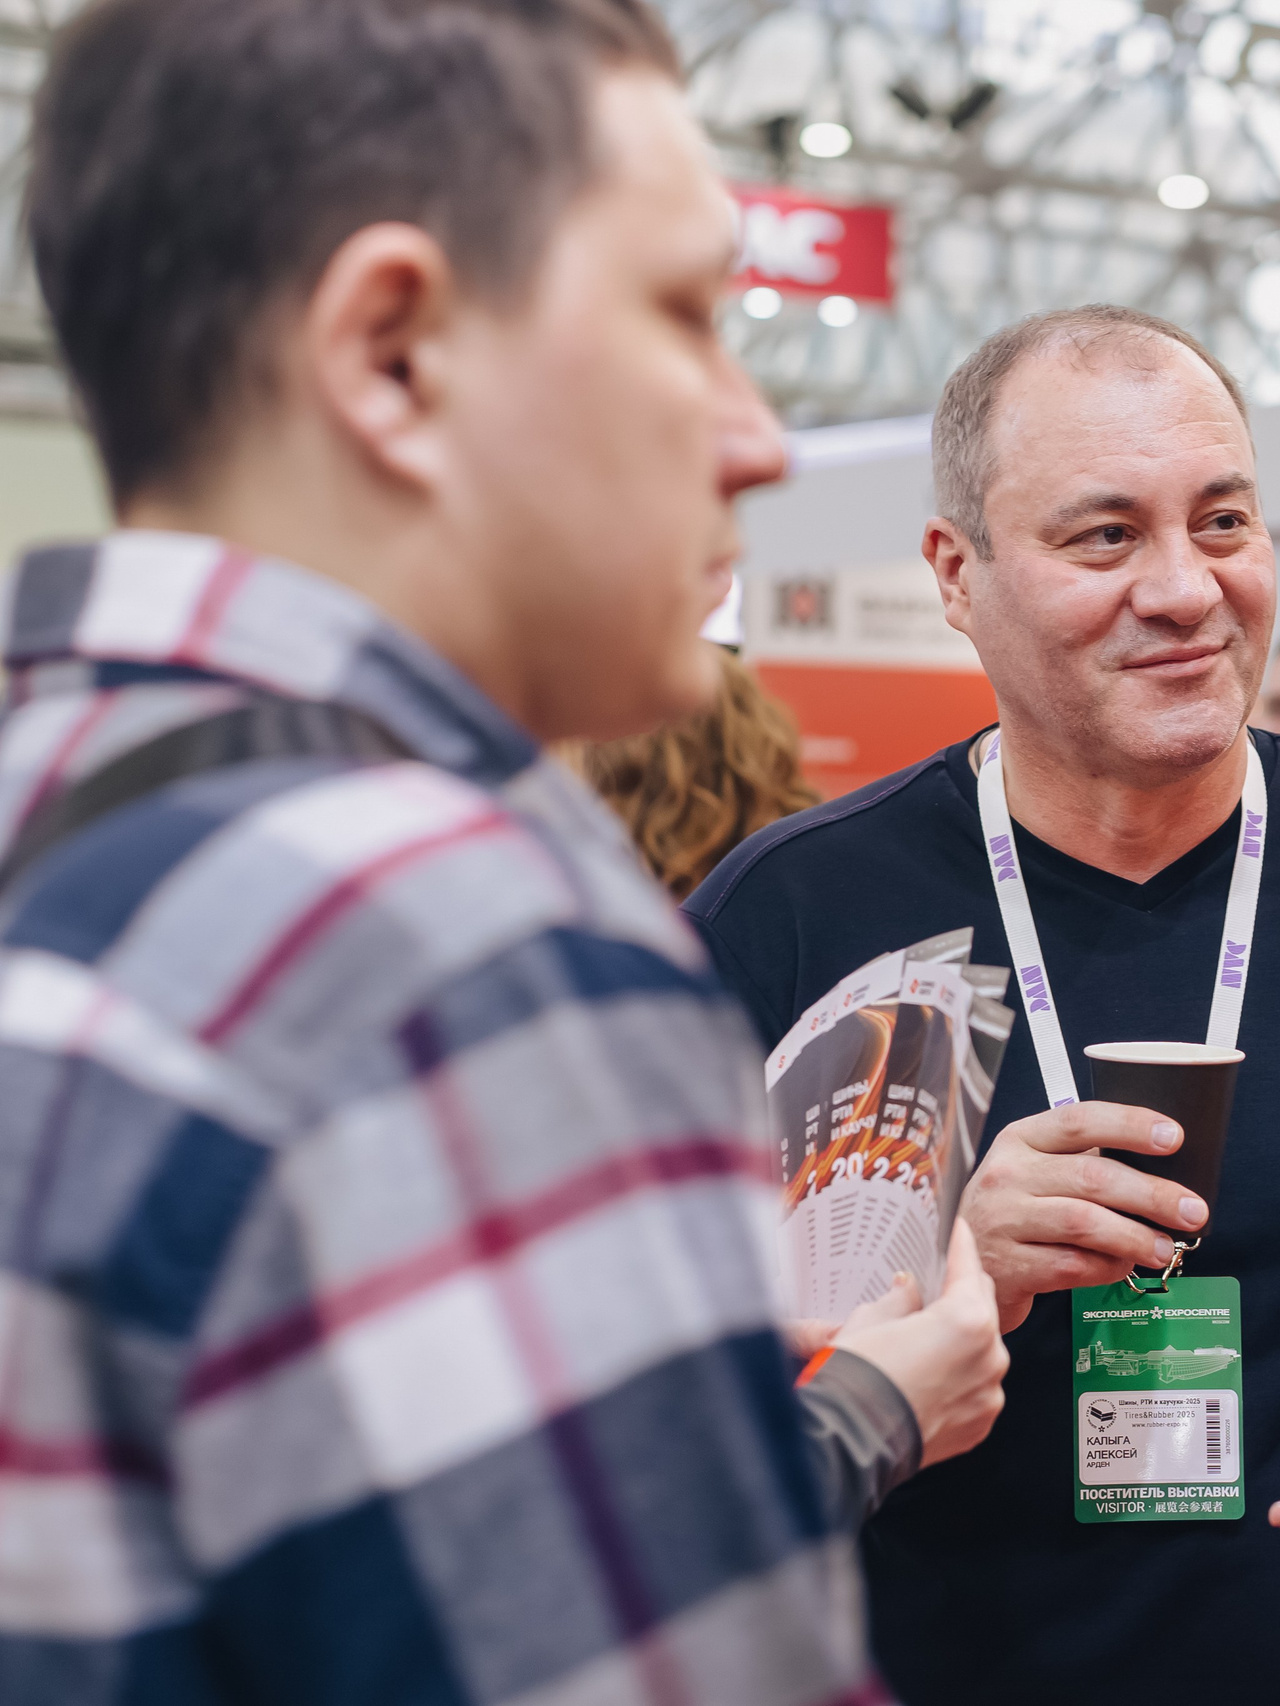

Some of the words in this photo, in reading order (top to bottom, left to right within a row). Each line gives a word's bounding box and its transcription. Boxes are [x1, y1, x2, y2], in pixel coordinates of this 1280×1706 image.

[1083, 1310, 1149, 1319] ЭКСПОЦЕНТР
[1165, 1308, 1230, 1317] EXPOCENTRE
[1124, 1411, 1175, 1419] Tires&Rubber
[1086, 1436, 1131, 1446] КАЛЫГА
[1086, 1448, 1137, 1459] АЛЕКСЕЙ
[1080, 1487, 1165, 1500] ПОСЕТИТЕЛЬ
[1168, 1486, 1239, 1498] ВЫСТАВКИ
[1096, 1501, 1145, 1513] VISITOR
[1155, 1501, 1223, 1513] 展览会参观者
